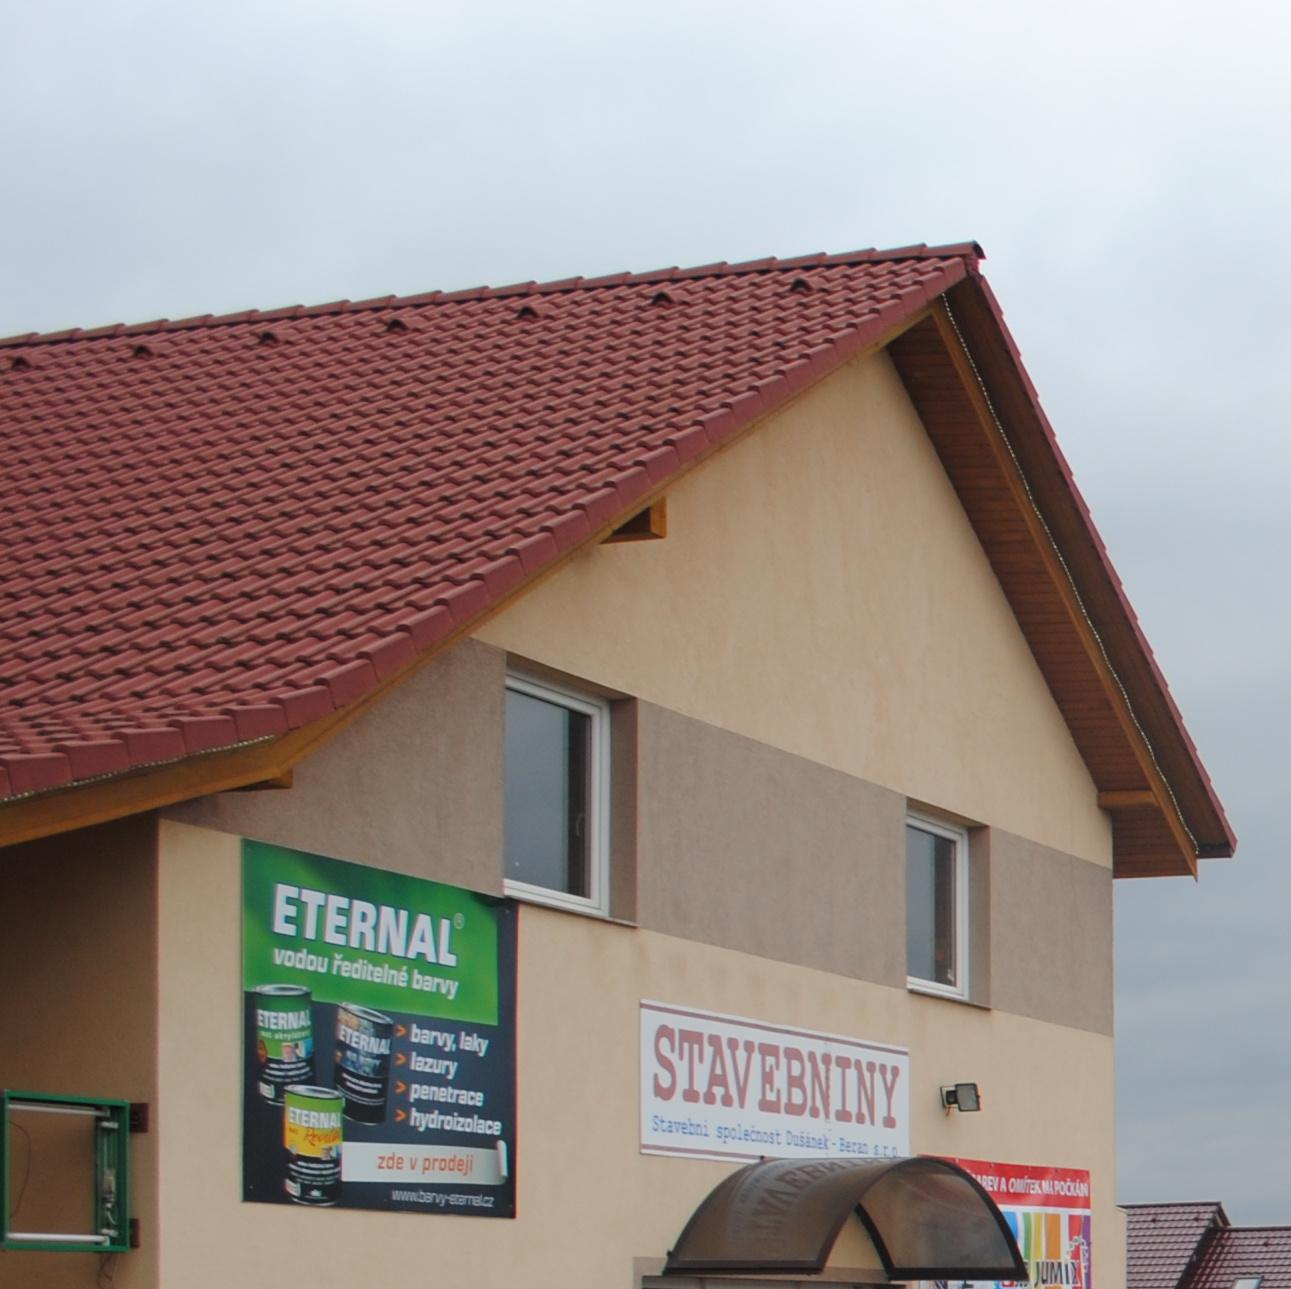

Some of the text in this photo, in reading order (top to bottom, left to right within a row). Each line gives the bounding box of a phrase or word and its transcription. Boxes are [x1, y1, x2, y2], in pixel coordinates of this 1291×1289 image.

[272, 883, 457, 967] ETERNAL
[274, 947, 459, 1000] vodou ředitelné barvy
[257, 1009, 311, 1030] ETERNAL
[338, 1024, 392, 1055] ETERNAL
[410, 1023, 489, 1057] barvy, laky
[410, 1051, 458, 1080] lazury
[652, 1023, 900, 1129] STAVEBNINY
[410, 1082, 484, 1107] penetrace
[288, 1106, 341, 1129] ETERNAL
[409, 1107, 502, 1136] hydroizolace
[652, 1115, 708, 1137] Stavební
[716, 1123, 781, 1146] společnost
[839, 1137, 869, 1154] Beran
[377, 1152, 474, 1177] zde v prodeji
[974, 1175, 999, 1192] AREV
[1000, 1176, 1007, 1192] A
[1034, 1260, 1080, 1289] JUMIX
